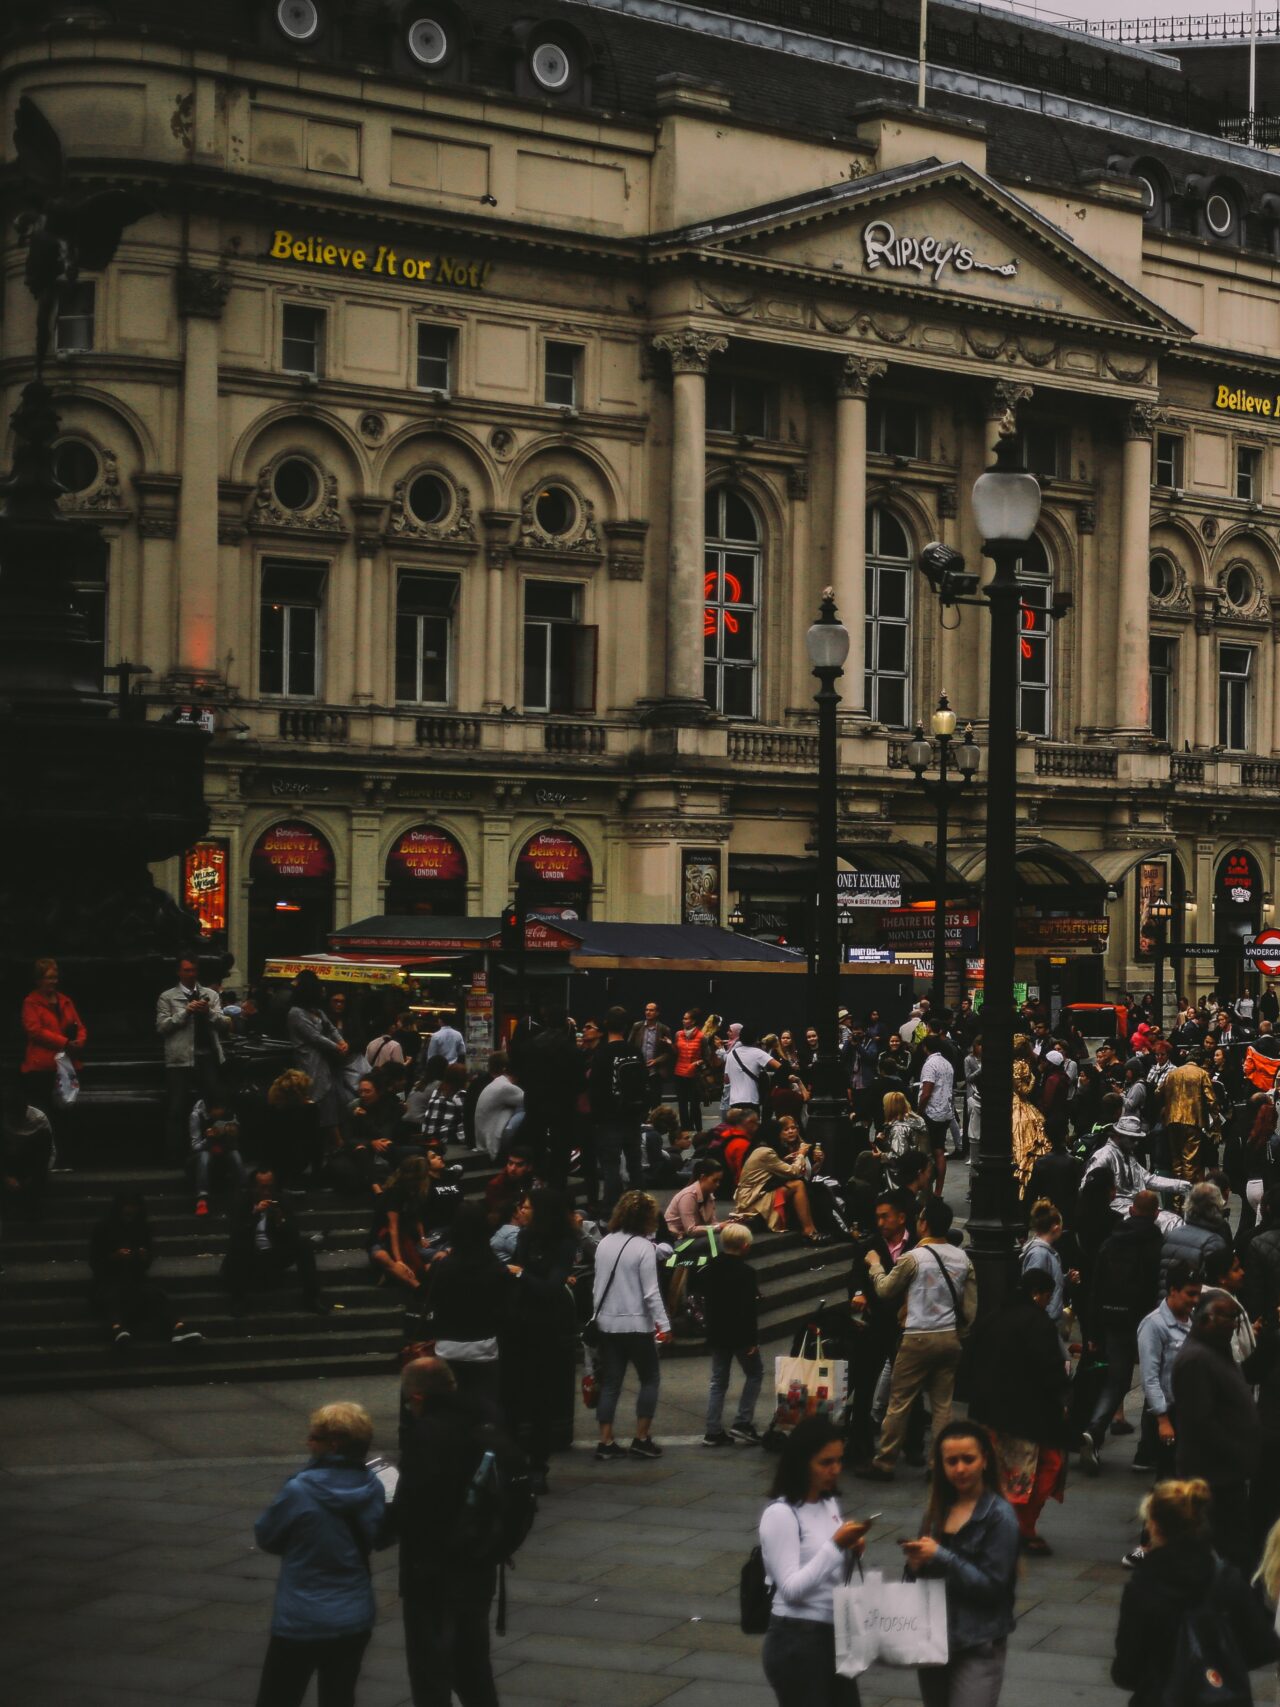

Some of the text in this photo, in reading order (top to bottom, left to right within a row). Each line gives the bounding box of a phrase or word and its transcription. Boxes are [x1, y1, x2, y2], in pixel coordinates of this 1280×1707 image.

[270, 230, 493, 289] Believe It or Not!
[1215, 384, 1271, 416] Believe
[279, 866, 304, 874] LONDON
[414, 868, 438, 877] LONDON
[542, 871, 564, 879] LONDON
[837, 873, 900, 888] ONEY EXCHANGE
[882, 915, 970, 928] THEATRE TICETS &
[888, 929, 962, 940] MONEY EXCNGE
[1056, 924, 1086, 934] TICKETS
[1087, 924, 1109, 933] HERE
